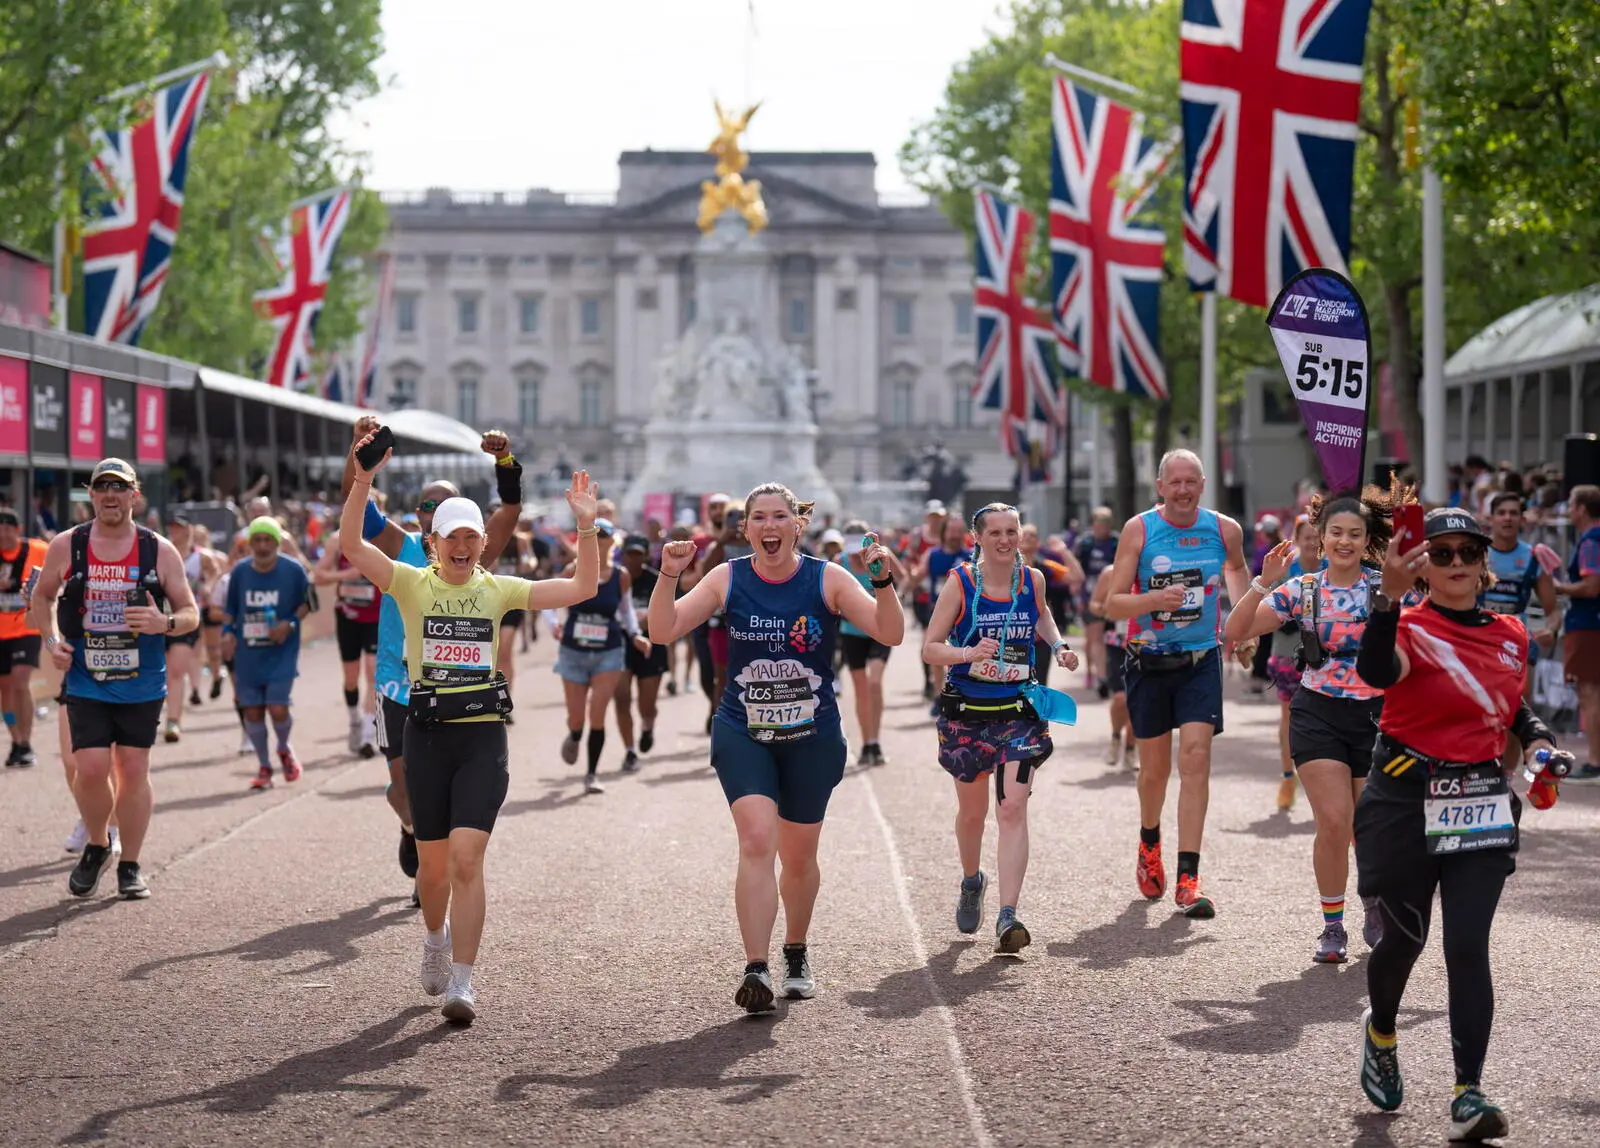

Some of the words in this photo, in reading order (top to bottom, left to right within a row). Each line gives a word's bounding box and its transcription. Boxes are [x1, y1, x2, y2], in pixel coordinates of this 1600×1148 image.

[1317, 300, 1346, 309] LONDON
[1314, 306, 1355, 317] MARATHON
[1314, 313, 1339, 323] EVENTS
[1305, 342, 1323, 353] SUB
[1296, 354, 1364, 399] 5:15
[1316, 421, 1362, 438] INSPIRING
[1314, 433, 1358, 448] ACTIVITY
[88, 565, 126, 578] MARTIN
[88, 578, 124, 590] SHARP
[431, 597, 481, 614] ALYX
[93, 613, 126, 623] TRUS
[750, 615, 785, 628] Brain
[1019, 612, 1030, 620] UK
[428, 620, 453, 636] tcs
[730, 626, 785, 641] Research
[433, 645, 481, 663] 22996
[768, 643, 785, 653] UK
[93, 654, 130, 667] 65235
[750, 663, 801, 679] MAURA
[748, 684, 771, 700] tcs
[773, 687, 807, 695] CONSULTANCY
[757, 706, 802, 723] 72177
[1438, 804, 1497, 826] 47877
[1462, 841, 1477, 849] new
[1478, 837, 1509, 847] balance
